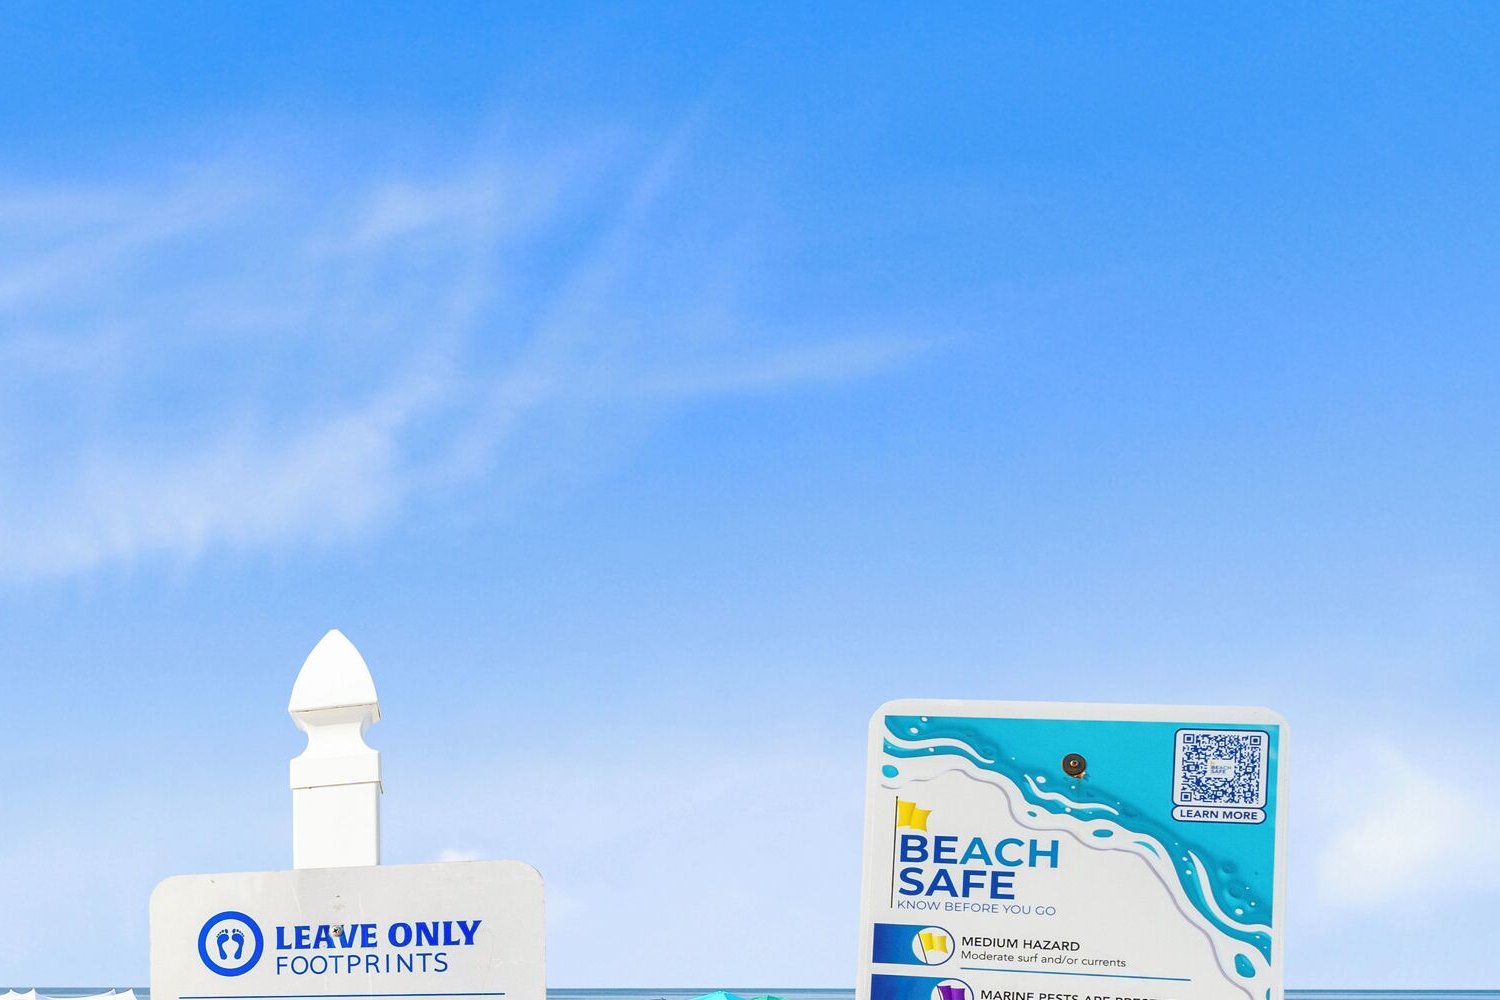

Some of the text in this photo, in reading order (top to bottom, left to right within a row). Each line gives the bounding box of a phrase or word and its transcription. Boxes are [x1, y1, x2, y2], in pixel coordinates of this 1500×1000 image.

[1180, 809, 1258, 820] LEARN MORE
[900, 834, 1059, 868] BEACH
[898, 867, 1016, 900] SAFE
[897, 900, 1056, 916] KNOW BEFORE YOU GO
[276, 920, 482, 950] LEAVE ONLY
[962, 936, 1080, 952] MEDIUM HAZARD
[276, 952, 448, 976] FOOTPRINTS
[961, 950, 1127, 968] Moderate surf and/or currents
